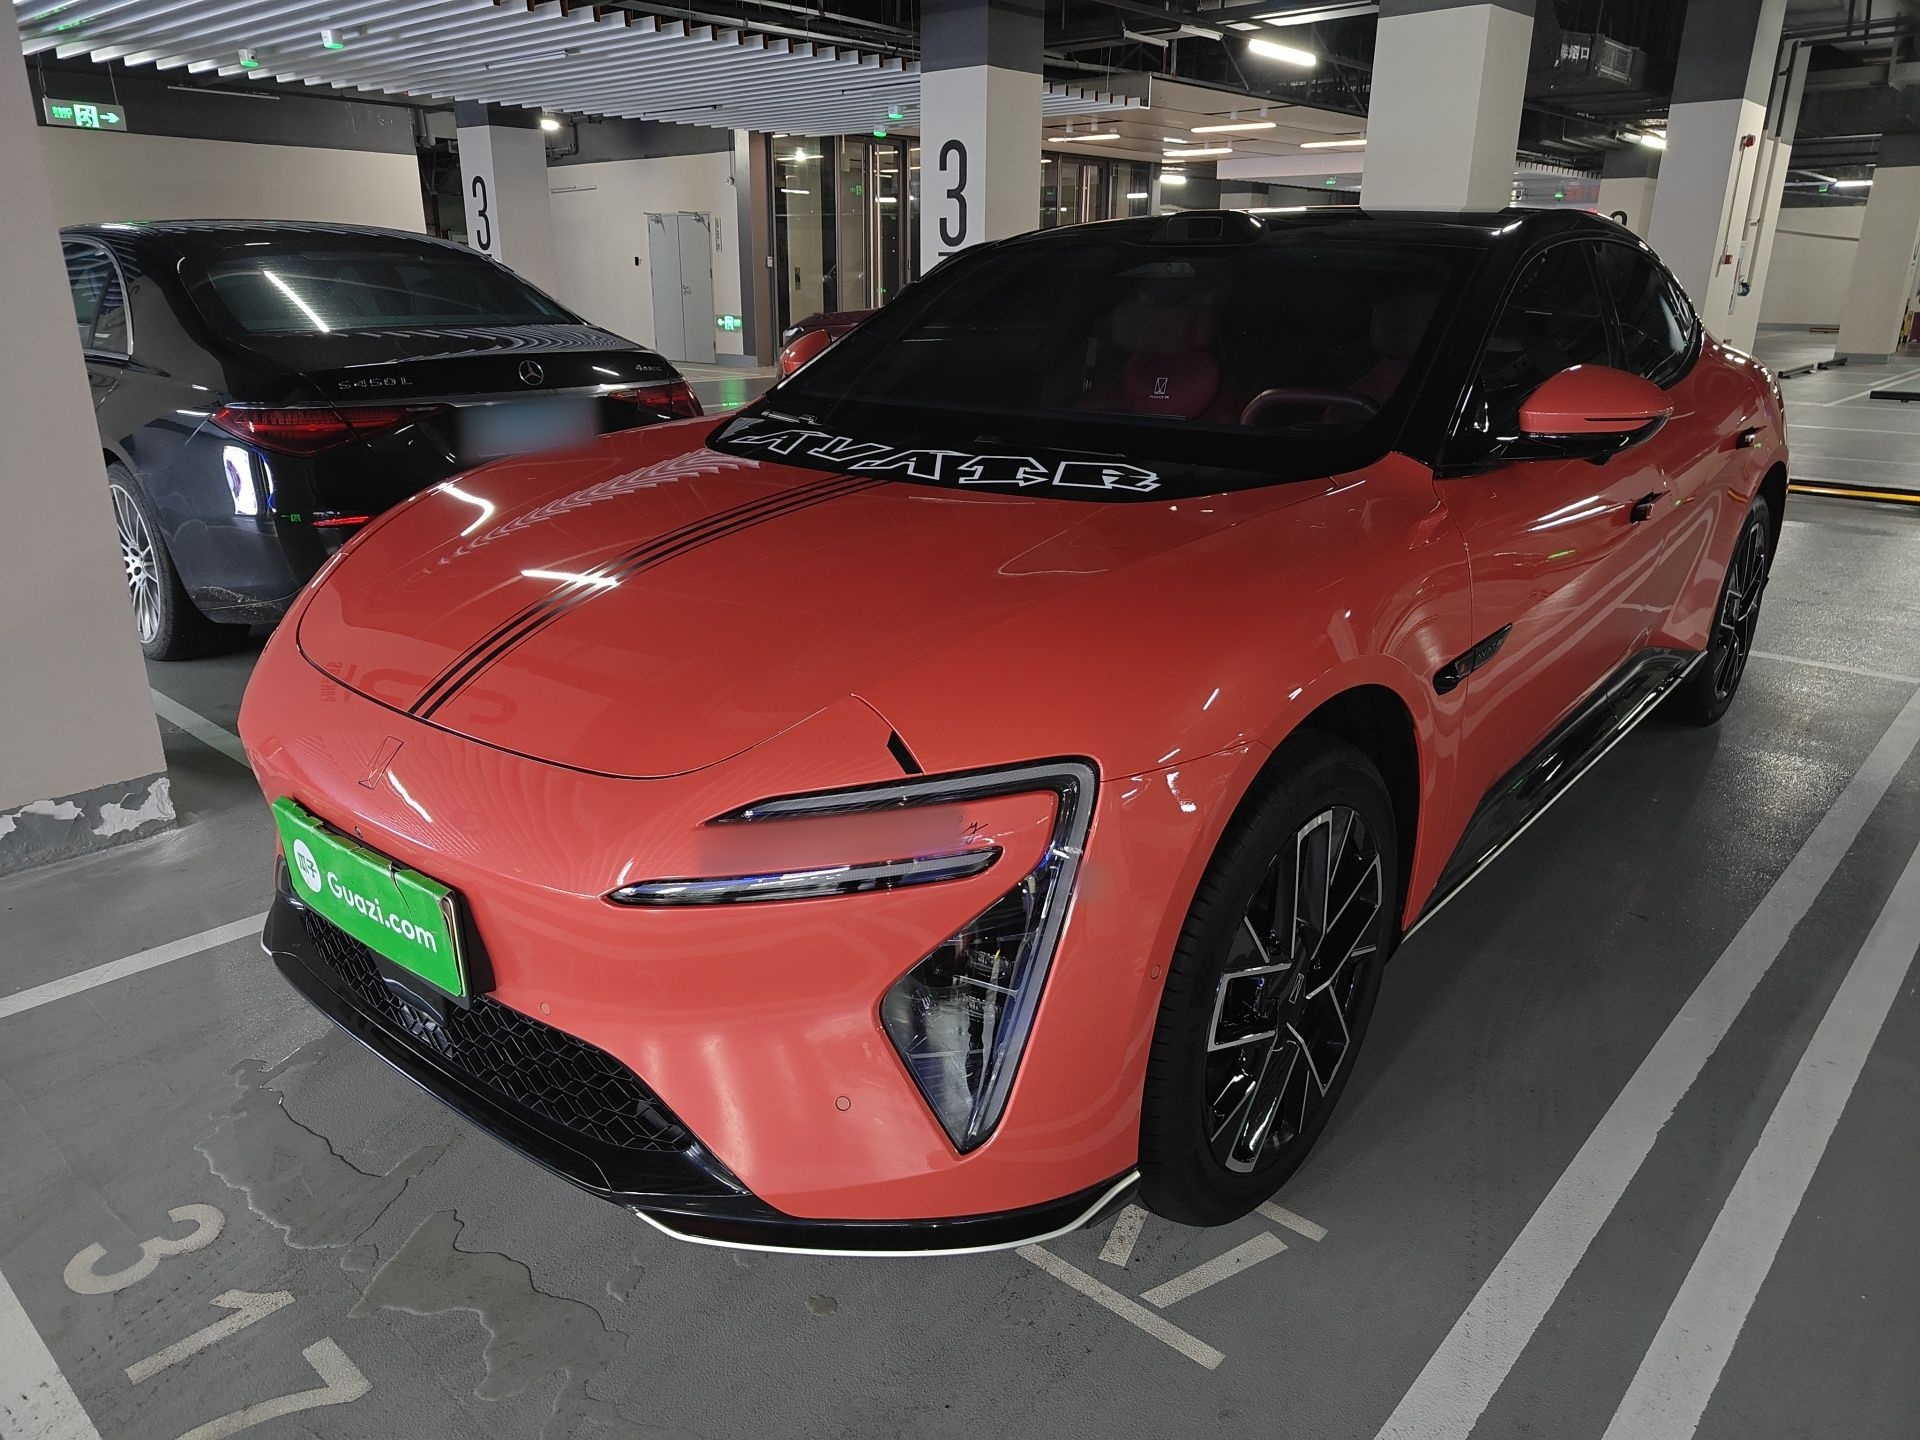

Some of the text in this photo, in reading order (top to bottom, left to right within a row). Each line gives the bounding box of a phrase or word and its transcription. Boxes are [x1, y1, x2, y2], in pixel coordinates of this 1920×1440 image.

[472, 175, 491, 251] 3
[939, 139, 967, 247] 3
[297, 851, 317, 879] 瓜子
[327, 871, 438, 953] Guazi.com
[64, 1203, 374, 1440] 317
